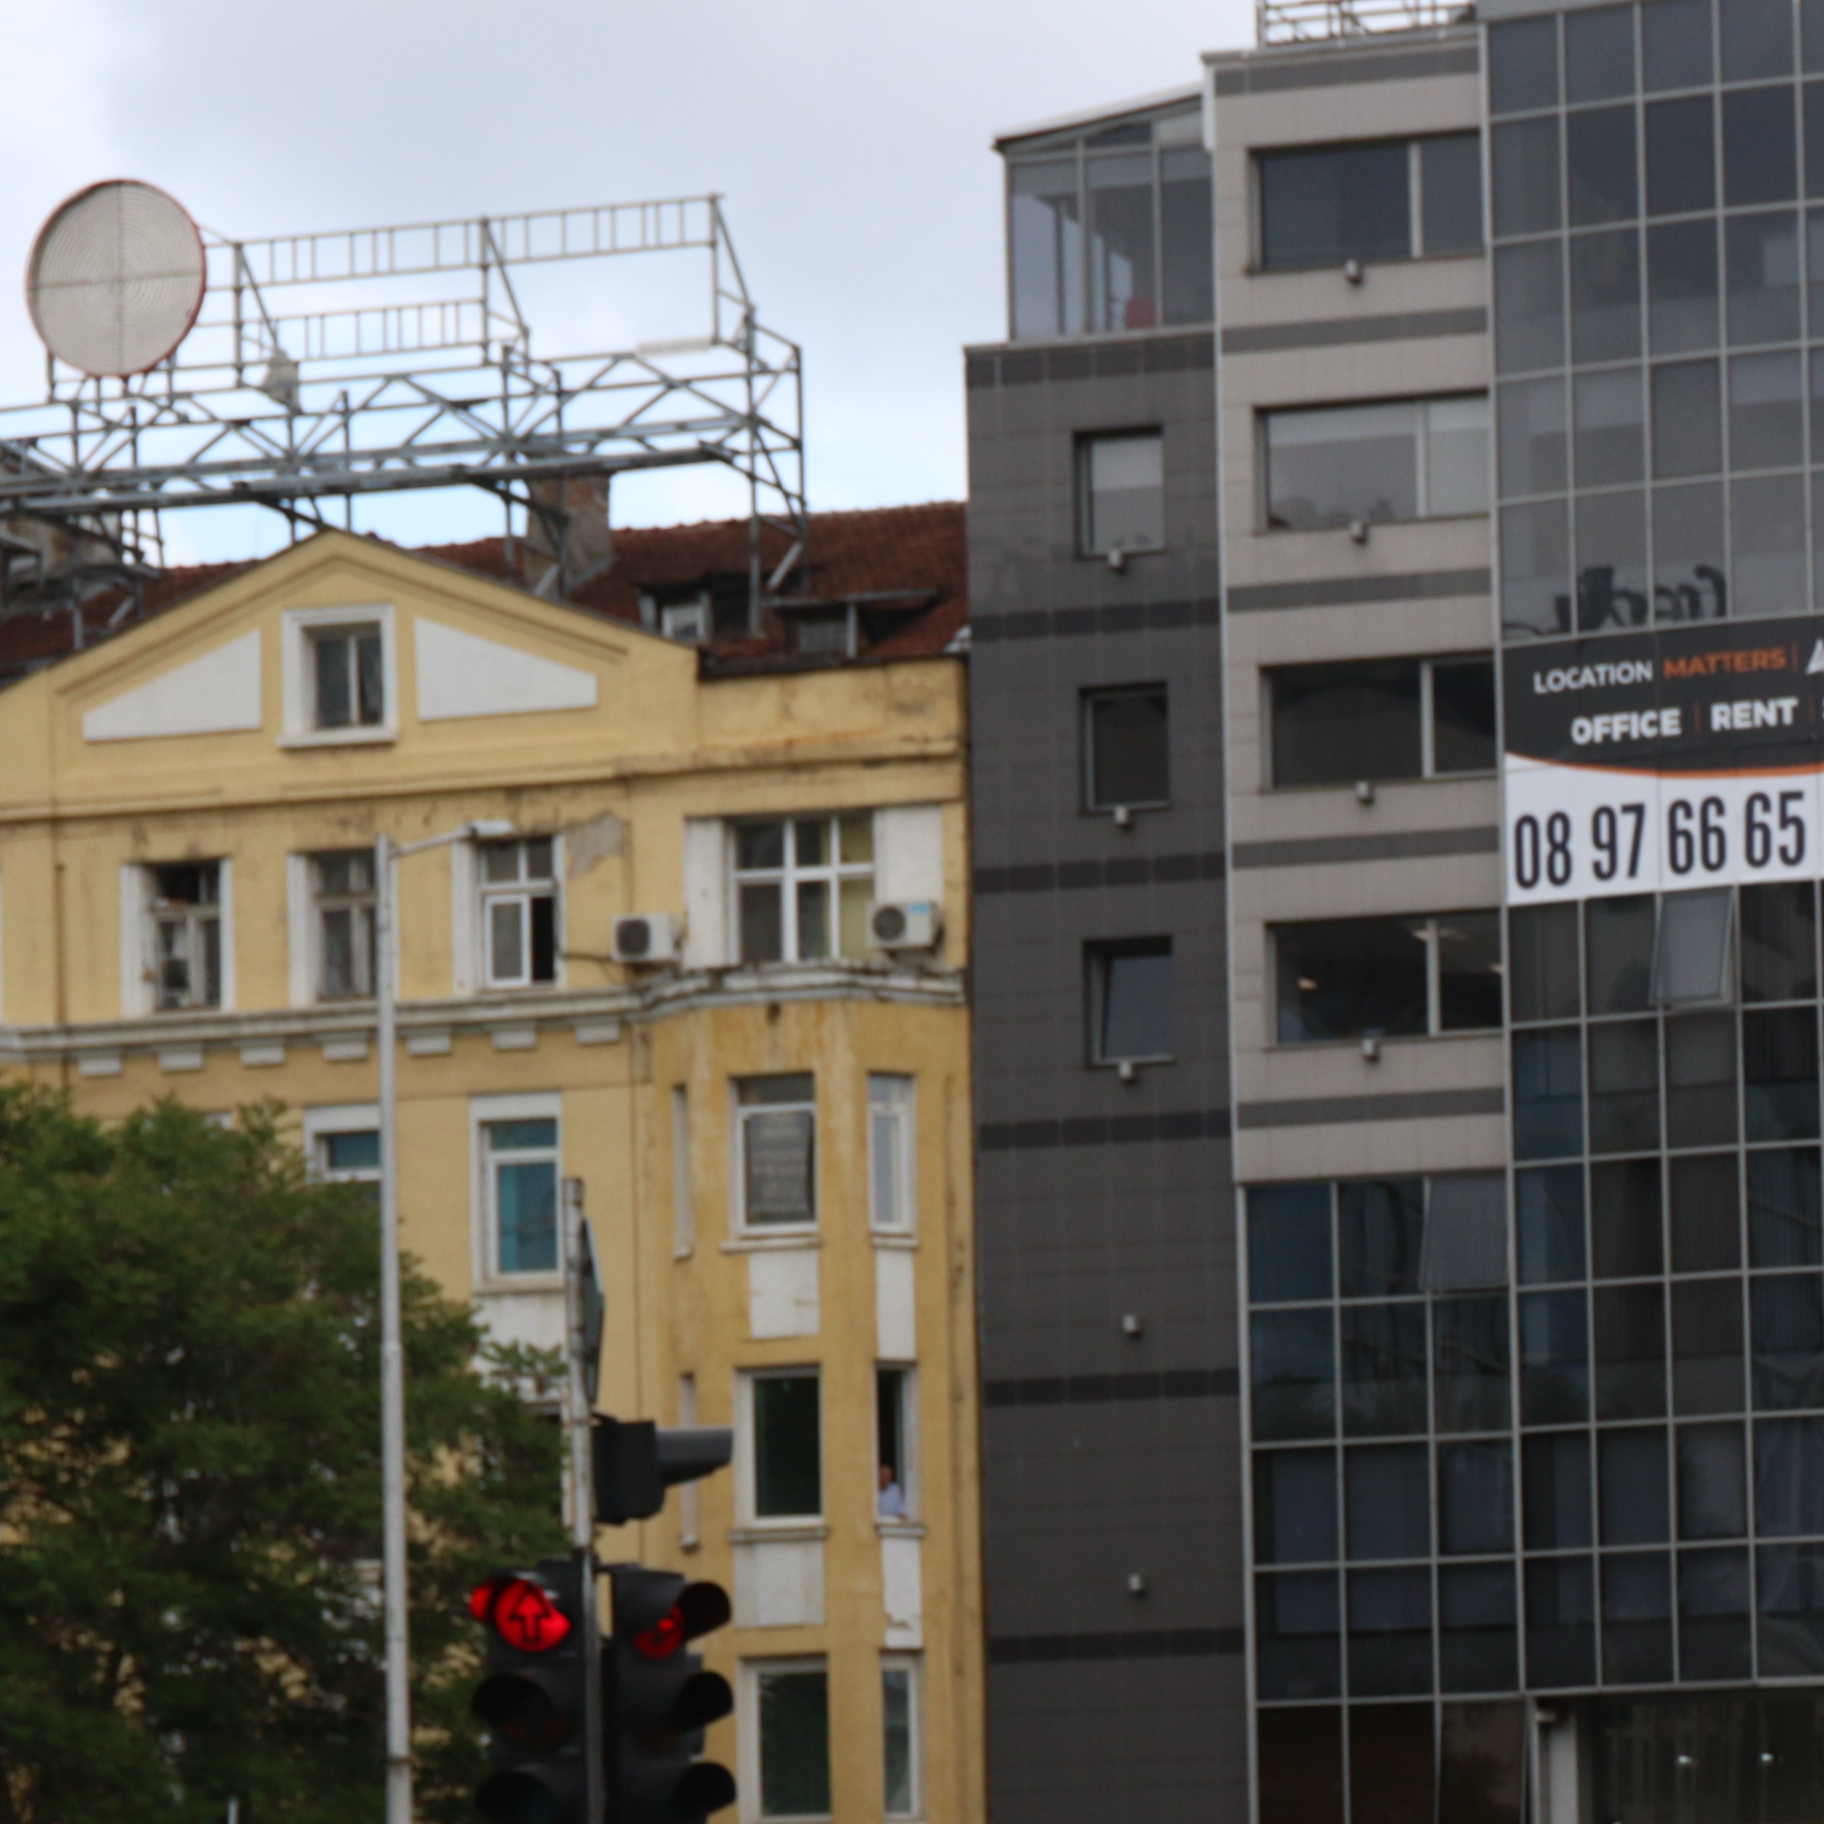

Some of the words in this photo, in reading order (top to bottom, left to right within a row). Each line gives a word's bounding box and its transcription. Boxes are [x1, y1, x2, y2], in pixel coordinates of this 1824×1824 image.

[1533, 660, 1653, 694] LOCATION
[1663, 646, 1787, 678] MATTERS
[1571, 707, 1682, 745] OFFICE
[1711, 697, 1798, 731] RENT
[1514, 812, 1571, 888] 08
[1592, 804, 1645, 880] 97
[1668, 796, 1726, 874] 66
[1744, 790, 1806, 867] 65
